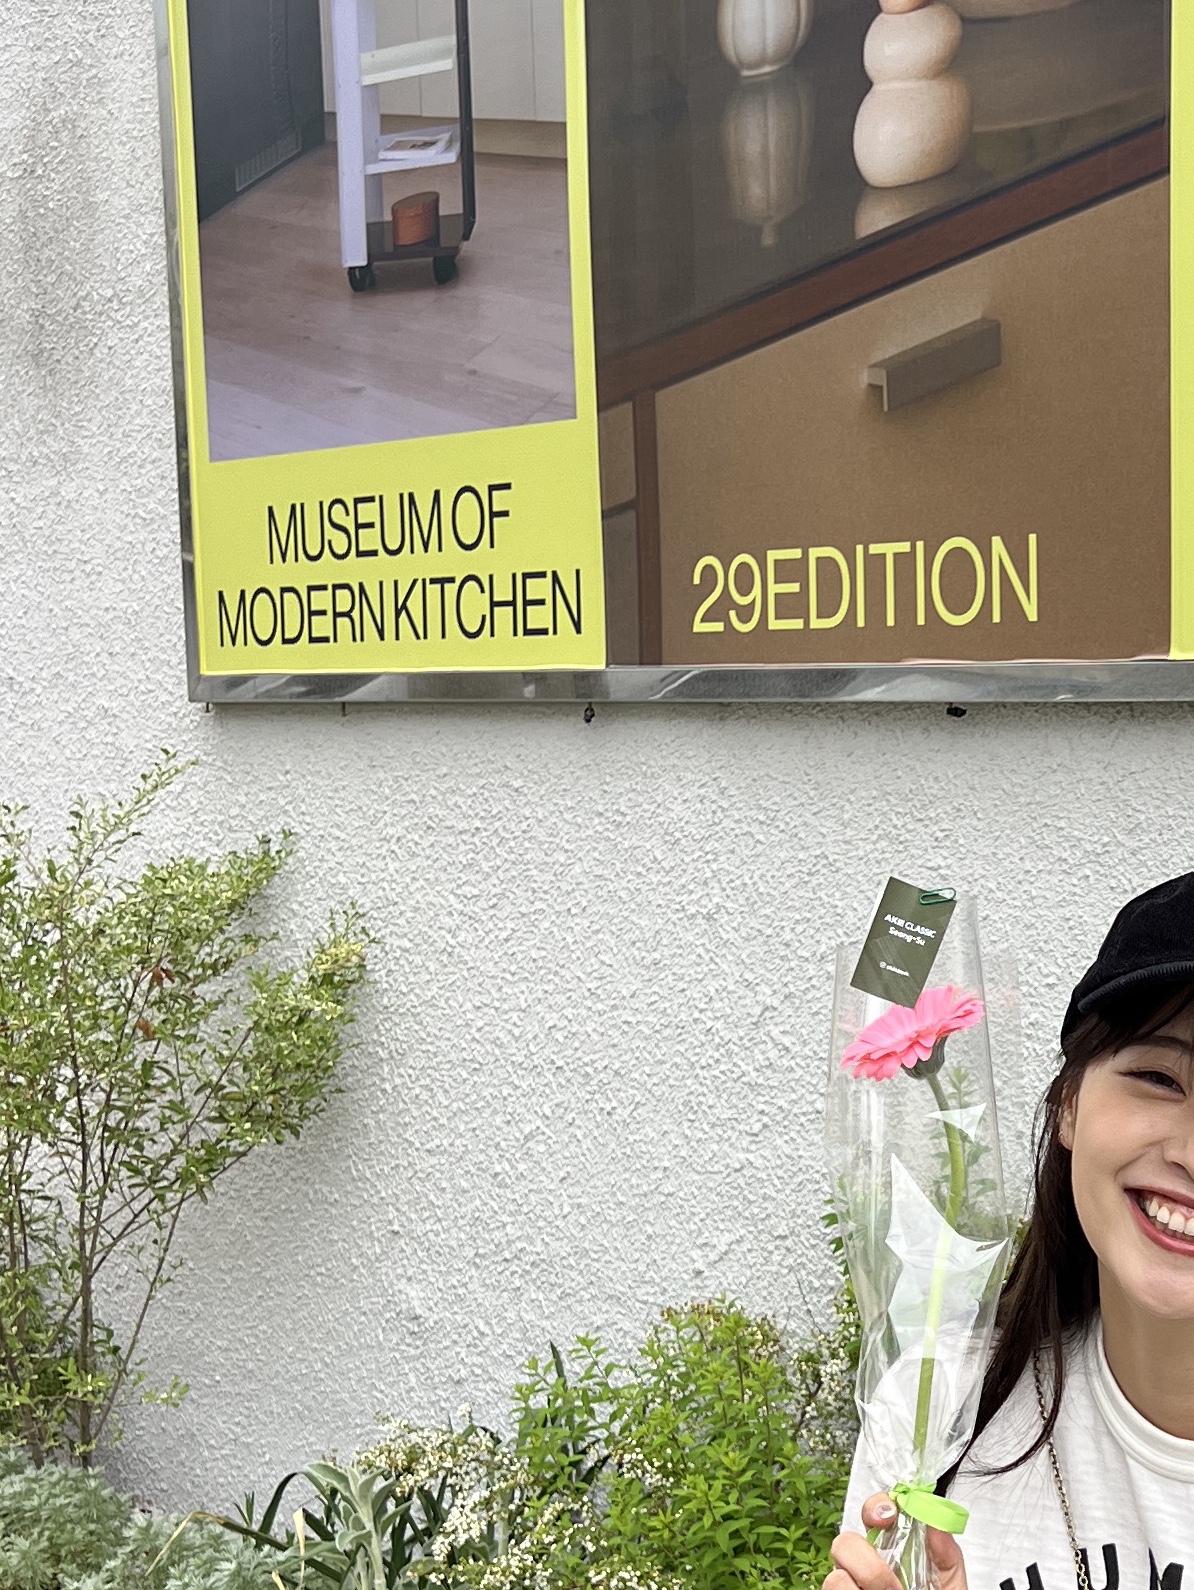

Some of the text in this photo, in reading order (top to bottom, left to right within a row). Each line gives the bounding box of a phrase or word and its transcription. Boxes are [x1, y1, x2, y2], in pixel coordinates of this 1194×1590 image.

[267, 482, 512, 565] MUSEUM OF
[217, 568, 582, 648] MODERN KITCHEN
[692, 533, 1038, 633] 29EDITION
[904, 921, 937, 939] CLASSIC
